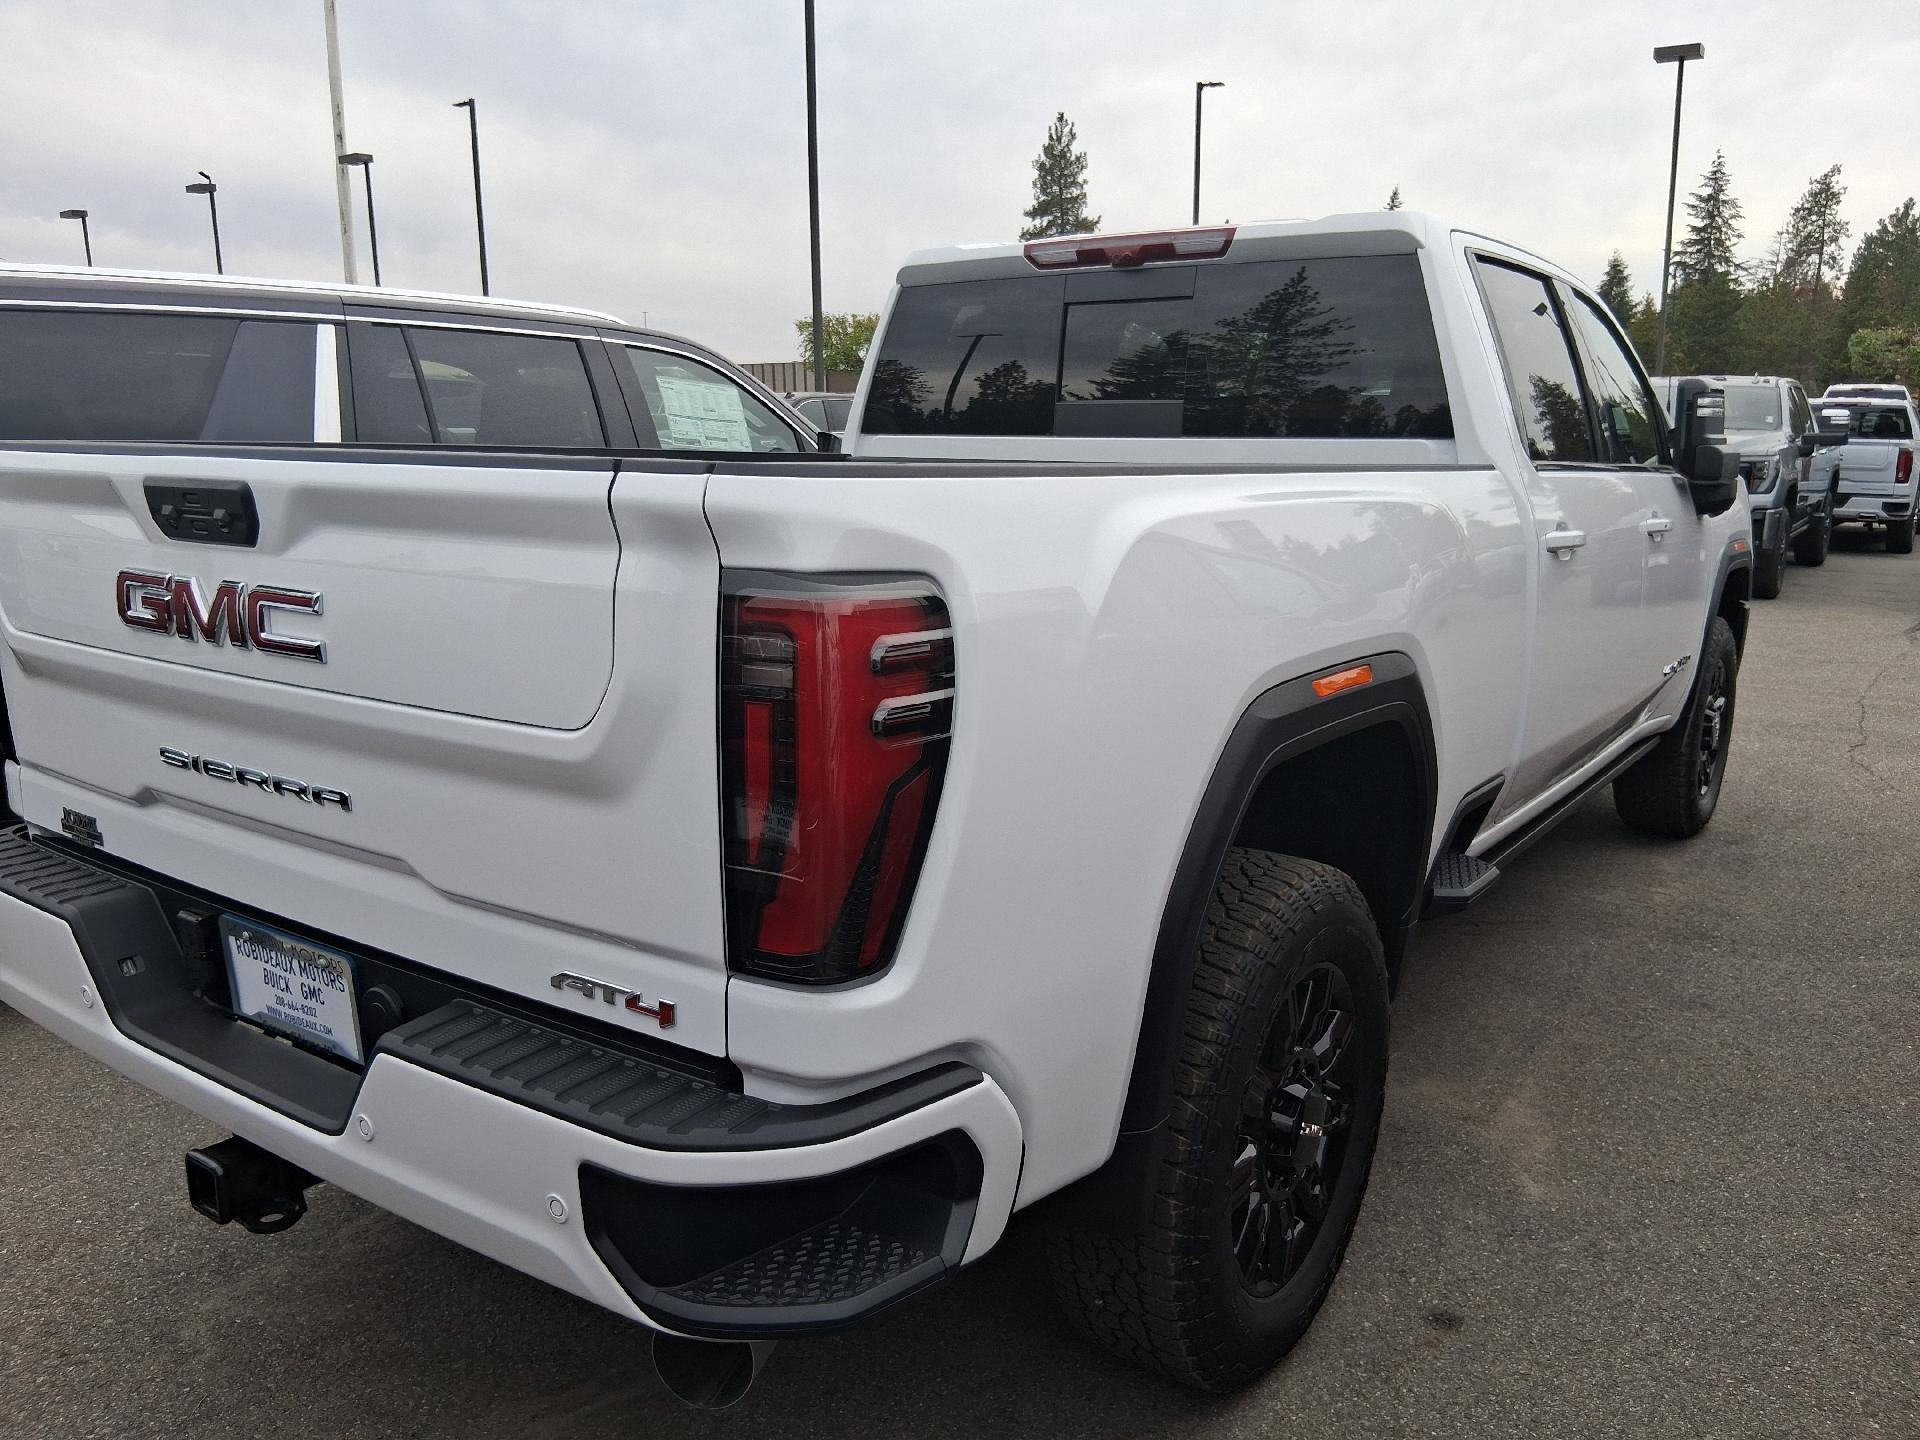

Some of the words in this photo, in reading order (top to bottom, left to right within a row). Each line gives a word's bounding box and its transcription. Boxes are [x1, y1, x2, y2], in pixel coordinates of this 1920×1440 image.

[117, 567, 327, 664] GMC
[160, 746, 352, 811] SIERRA
[235, 937, 296, 976] ROBIDEAUX
[298, 960, 345, 993] MOTORS
[263, 968, 293, 995] BUICK
[300, 982, 326, 1006] GMC
[550, 970, 677, 1029] AT4
